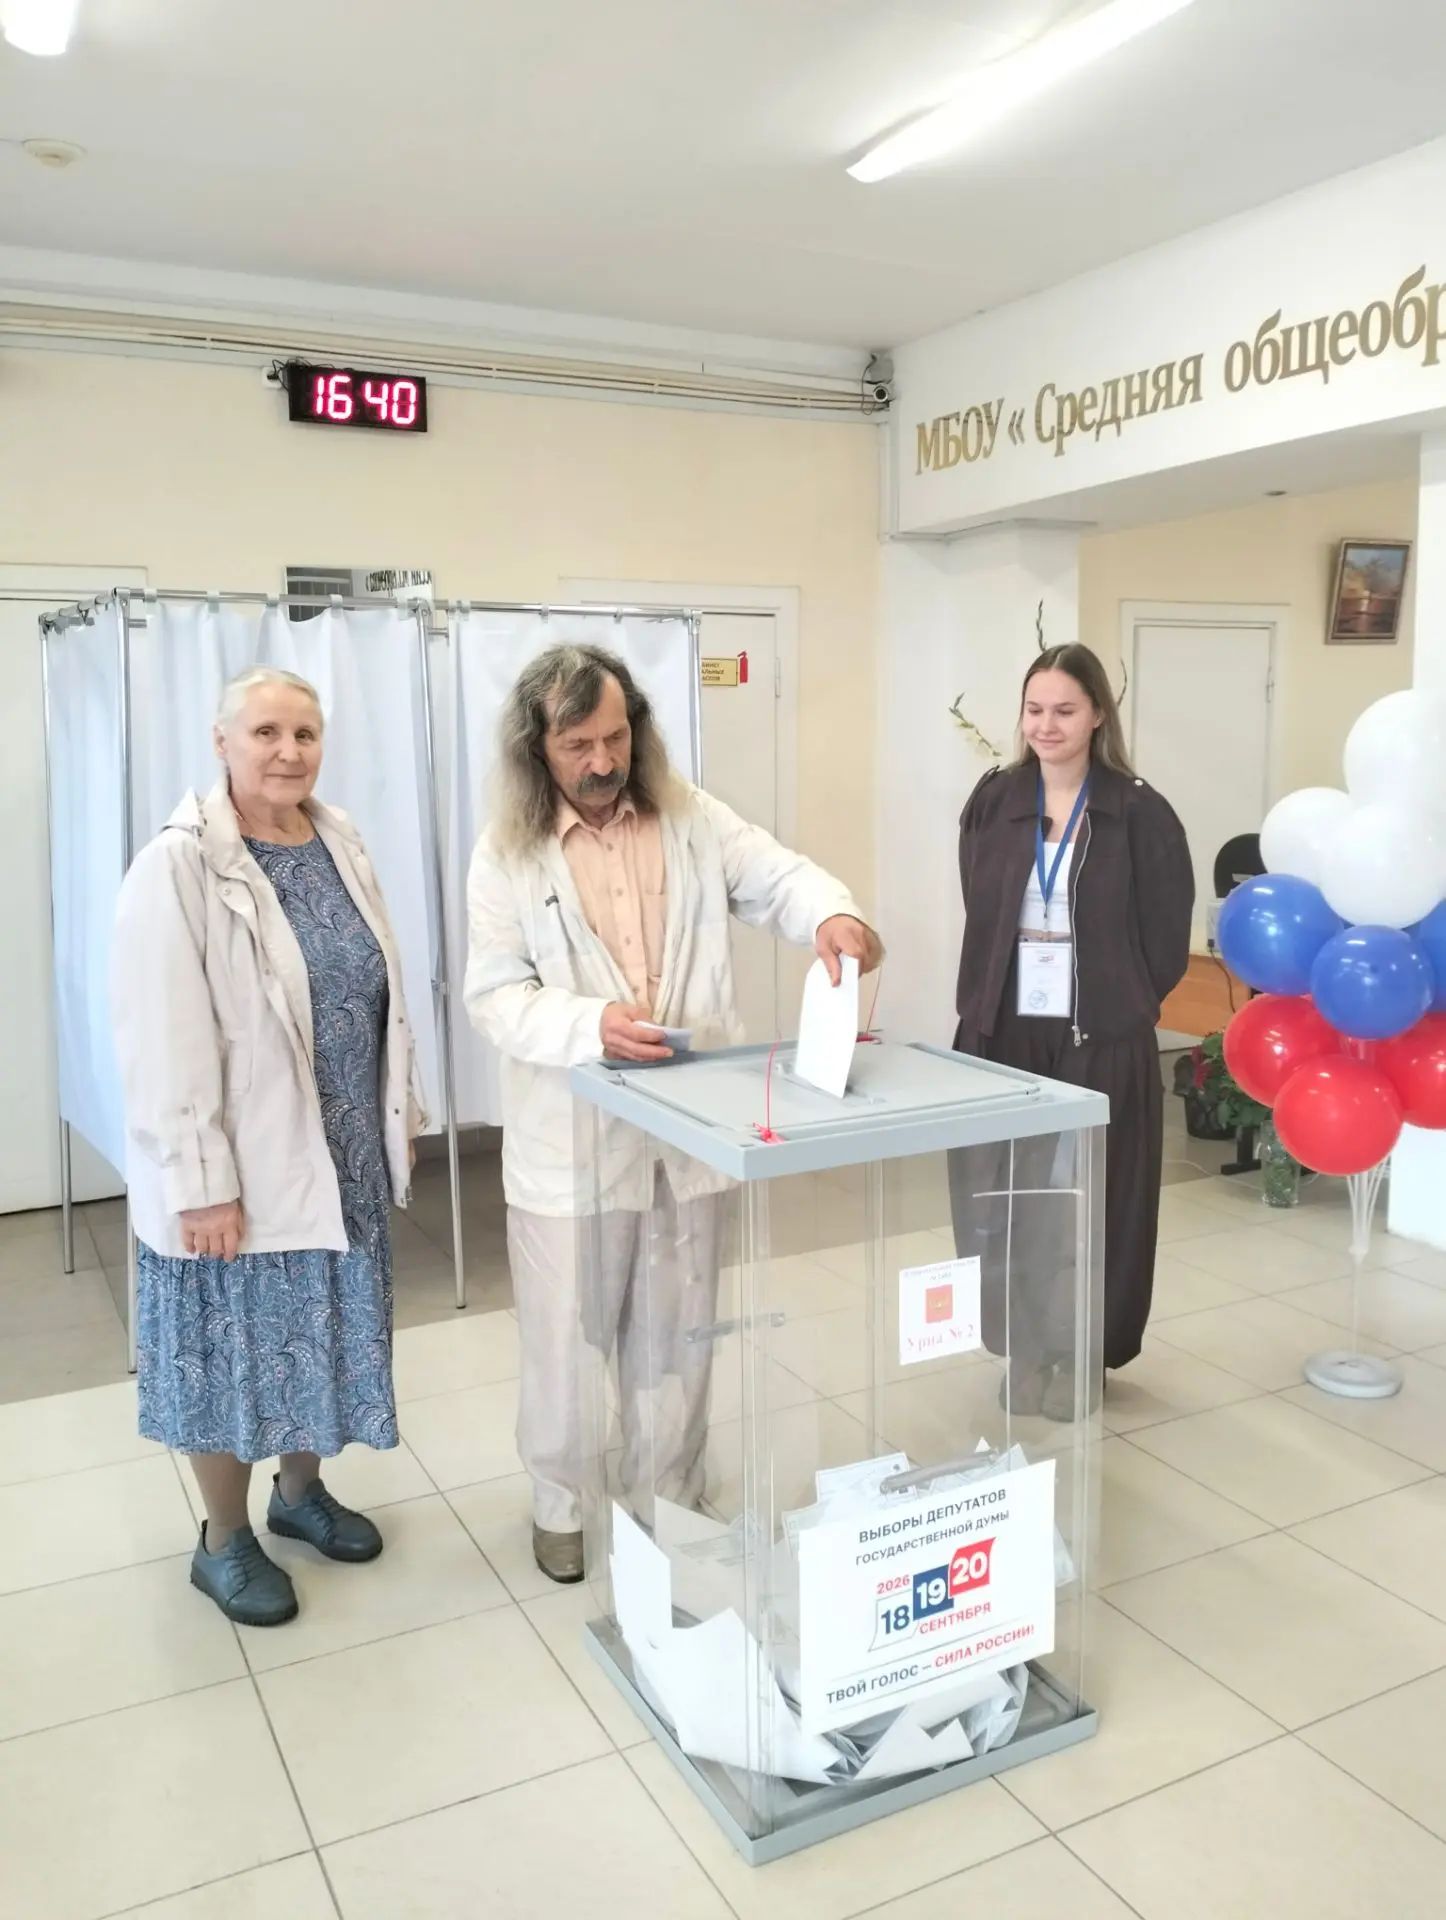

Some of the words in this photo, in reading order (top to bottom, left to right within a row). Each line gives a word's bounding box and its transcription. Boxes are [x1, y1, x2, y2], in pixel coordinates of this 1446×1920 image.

[314, 375, 353, 419] 16
[364, 381, 417, 424] 40
[915, 398, 1005, 475] МБОУ
[1007, 407, 1025, 446] «
[1035, 352, 1204, 457] Средняя
[855, 1523, 973, 1566] ГОСУДАРСТВЕННОЙ
[975, 1510, 1009, 1532] ДУМЫ
[859, 1514, 923, 1544] ВЫБОРЫ
[926, 1488, 1007, 1524] ДЕПУТАТОВ
[876, 1574, 910, 1595] 2026
[881, 1605, 910, 1635] 18
[916, 1577, 947, 1610] 19
[952, 1551, 988, 1586] 20
[919, 1602, 992, 1635] СЕНТЯБРЯ
[826, 1680, 867, 1704] ТВОЙ
[871, 1664, 919, 1690] ГОЛОС
[935, 1645, 973, 1669] СИЛА
[976, 1624, 1035, 1654] РОССИИ!
